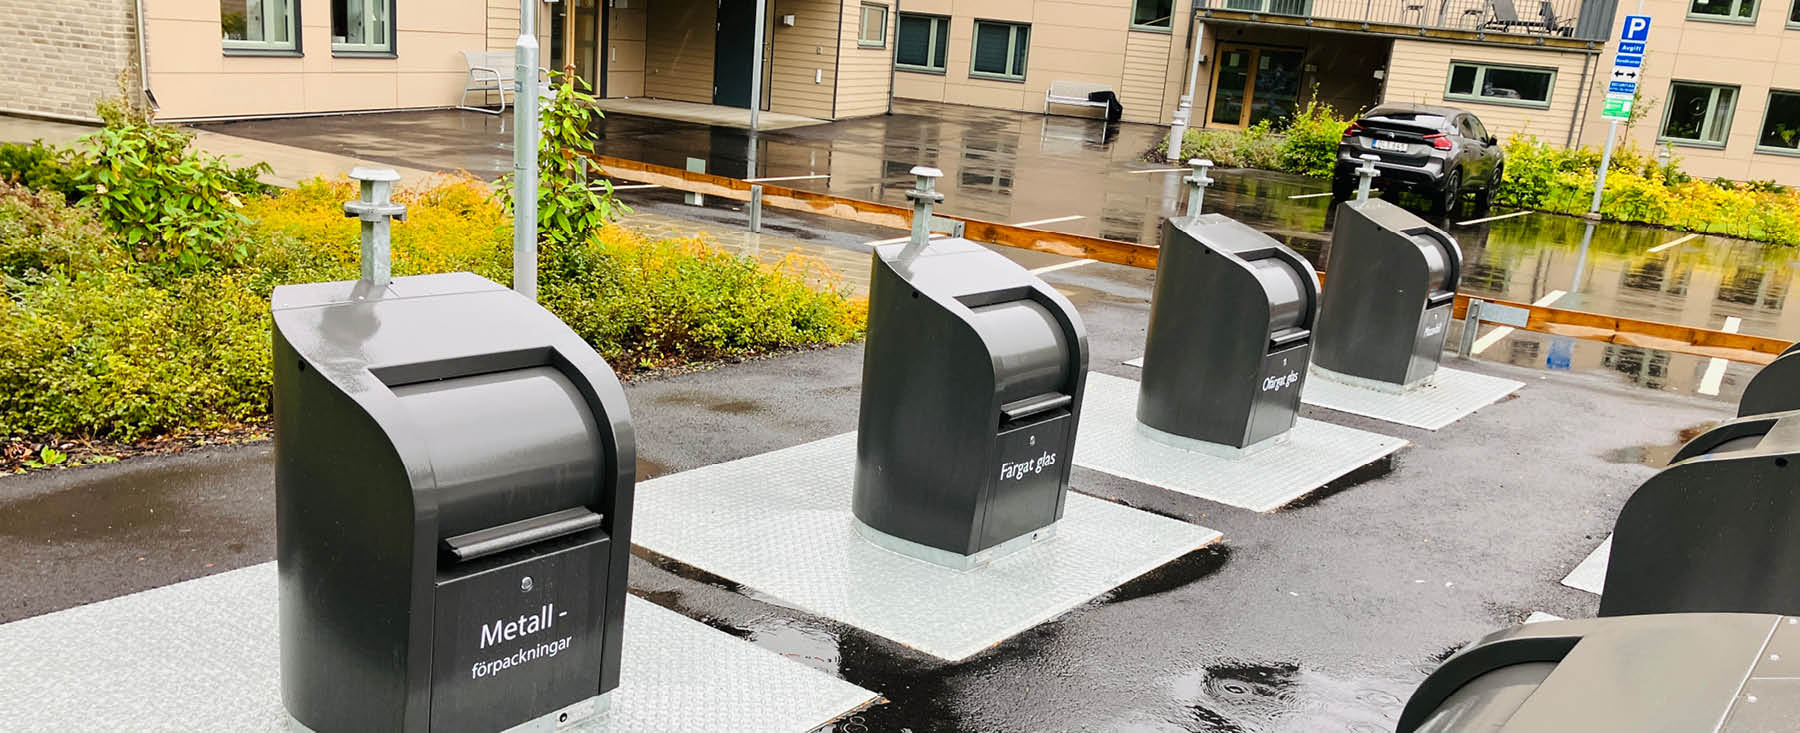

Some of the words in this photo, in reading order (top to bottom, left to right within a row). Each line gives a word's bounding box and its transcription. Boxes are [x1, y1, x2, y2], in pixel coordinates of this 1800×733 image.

[1627, 17, 1646, 39] P
[1000, 459, 1035, 480] Färgat
[1035, 450, 1056, 474] glas
[479, 603, 553, 649] Metall
[471, 635, 572, 679] förpackningar
